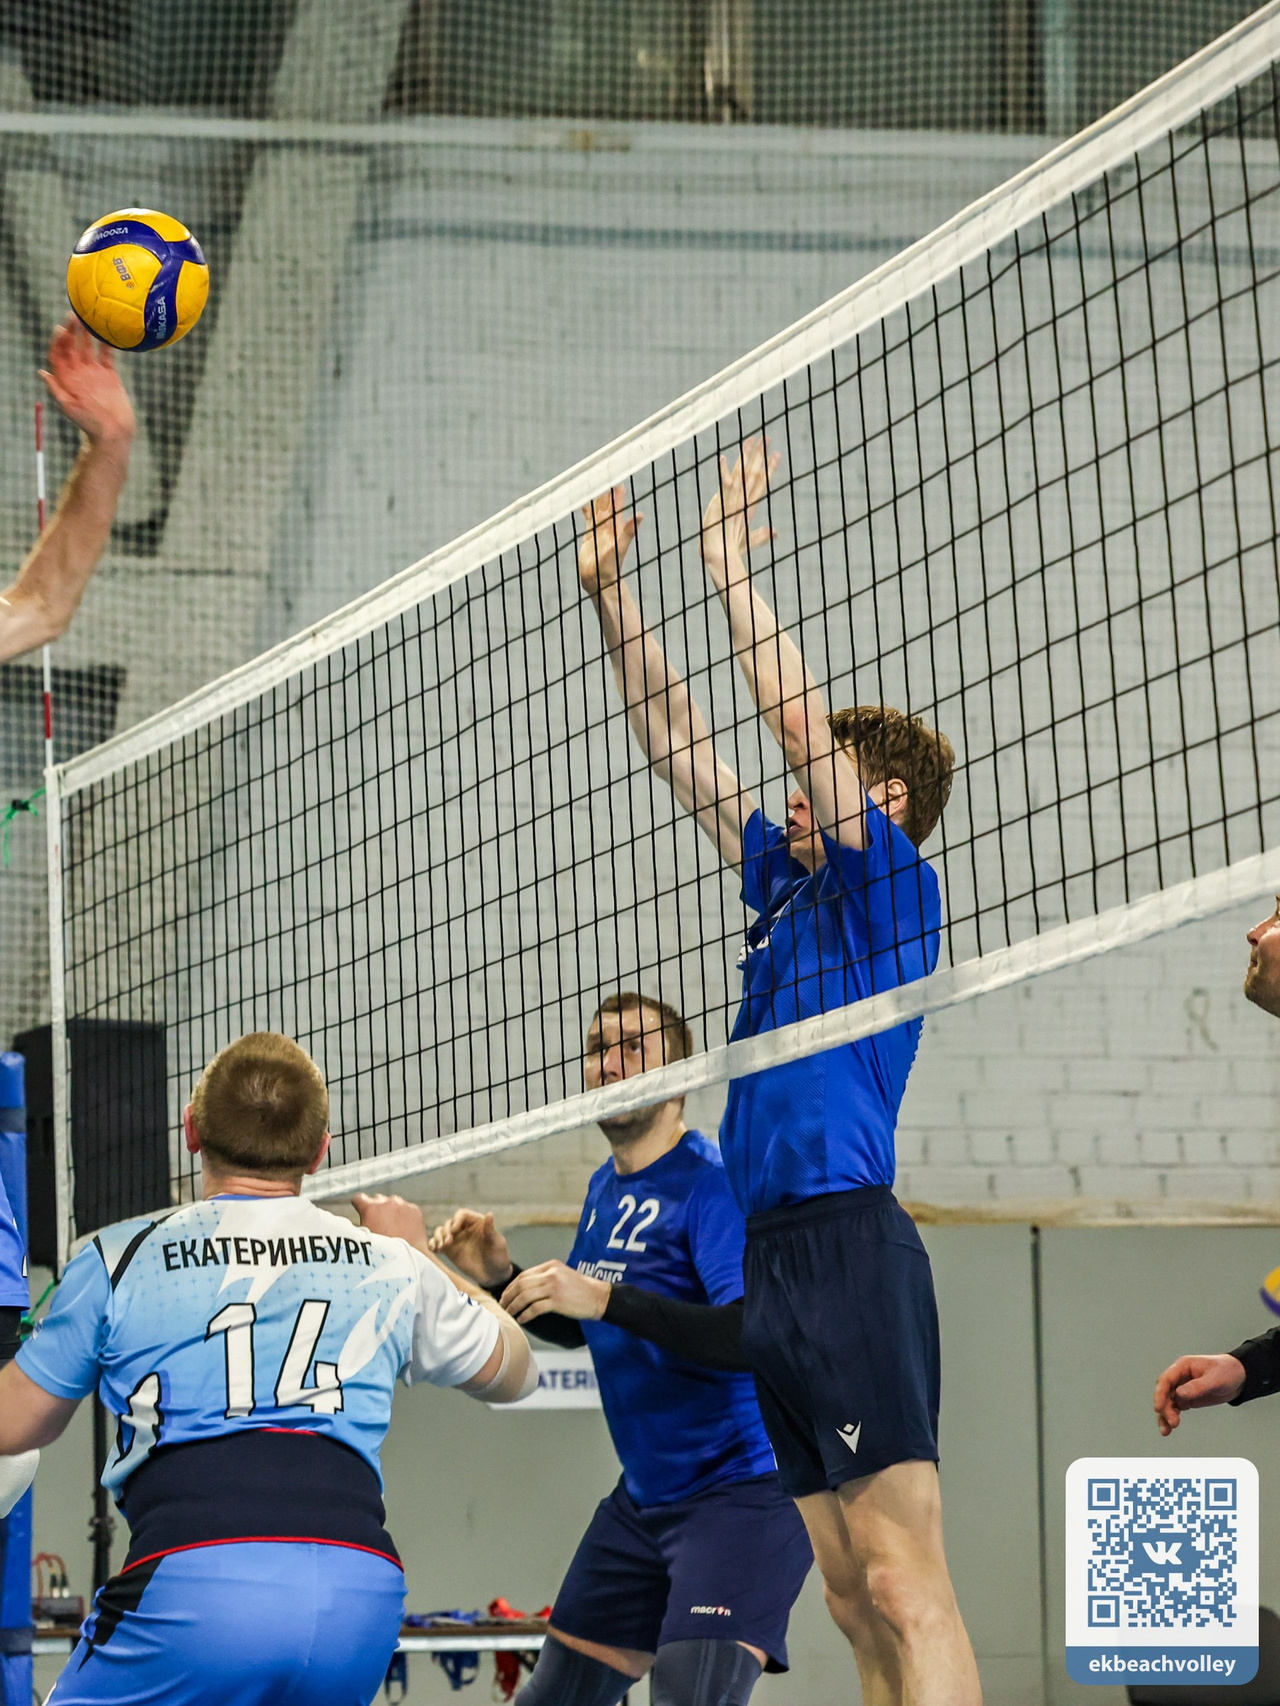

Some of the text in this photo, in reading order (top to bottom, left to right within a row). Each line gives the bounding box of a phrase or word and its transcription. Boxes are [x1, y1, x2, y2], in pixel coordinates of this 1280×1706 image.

[156, 296, 166, 340] MIKASA
[606, 1194, 660, 1252] 22
[162, 1235, 371, 1271] ЕКАТЕРИНБУРГ
[204, 1299, 344, 1419] 14
[690, 1605, 731, 1616] macron
